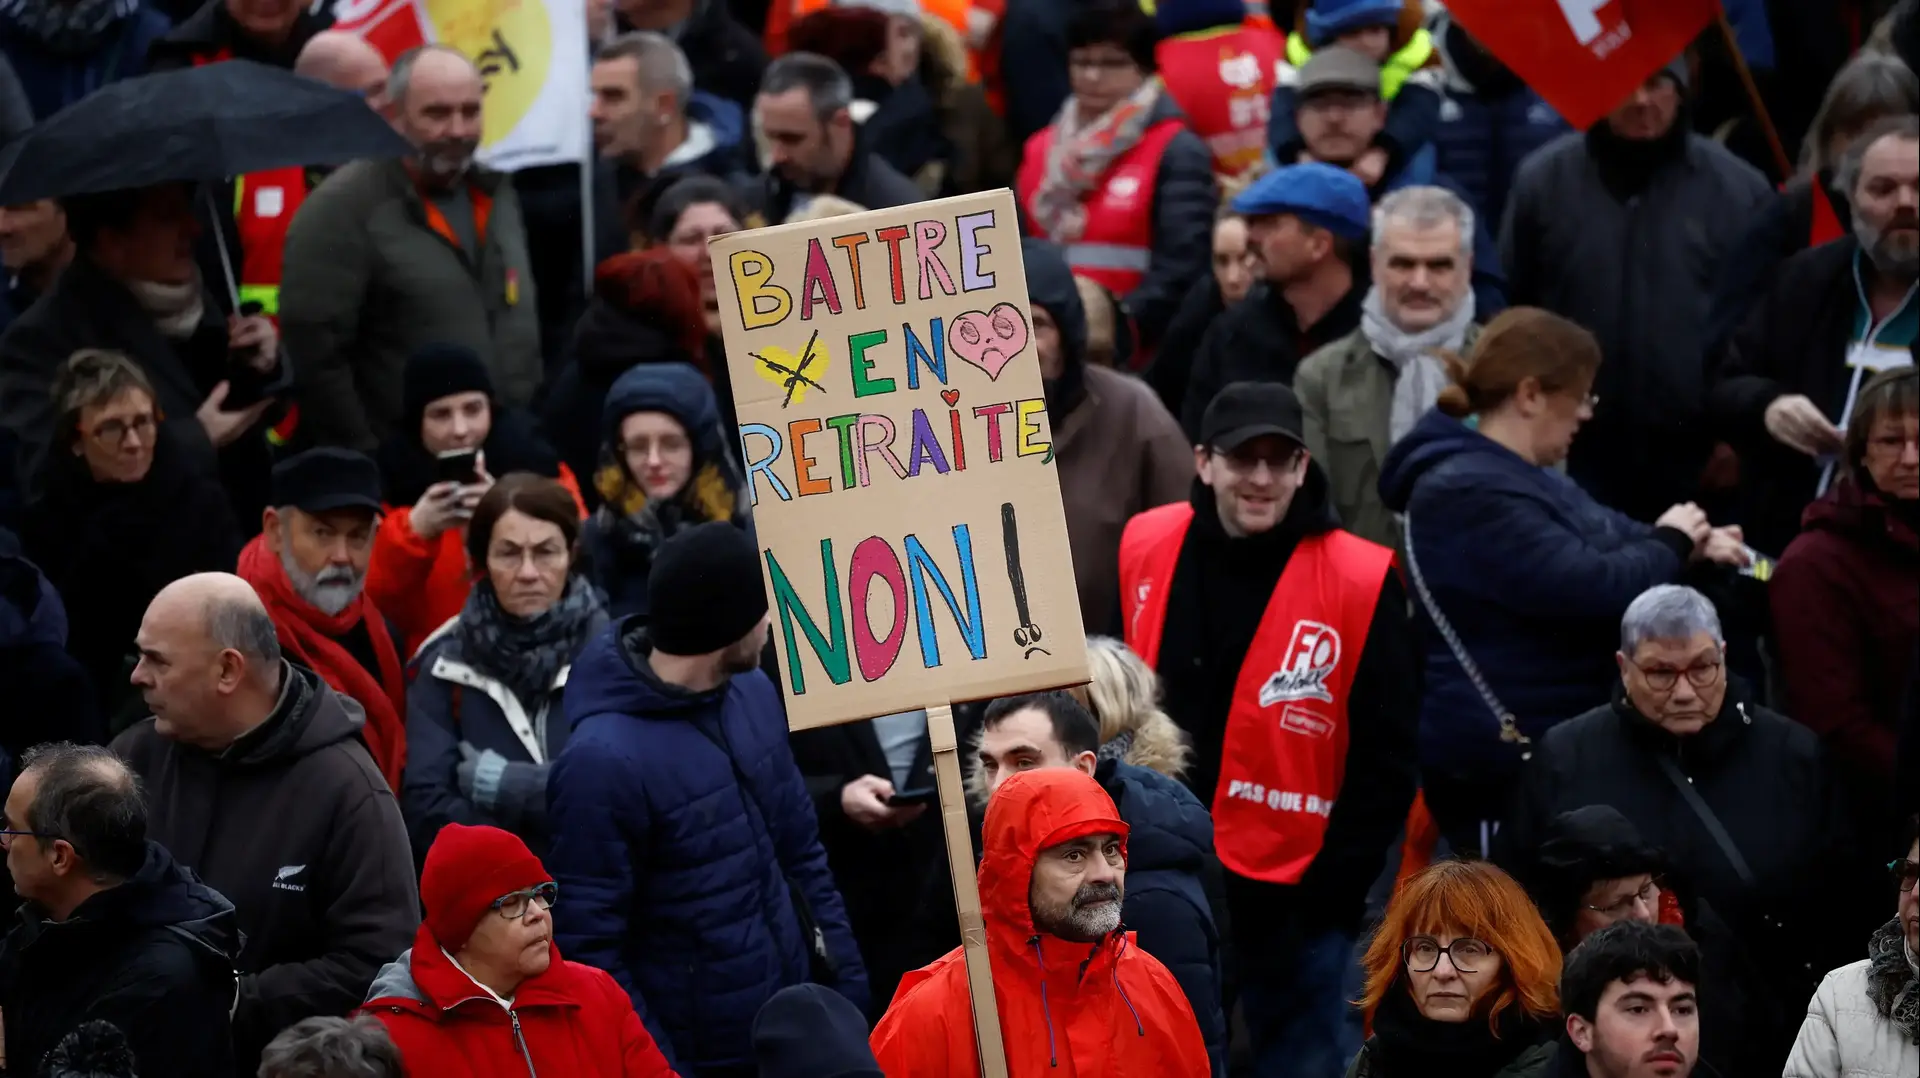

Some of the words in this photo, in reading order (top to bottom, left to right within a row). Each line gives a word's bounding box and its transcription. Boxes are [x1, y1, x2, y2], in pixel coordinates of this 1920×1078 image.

[729, 210, 997, 331] BATTRE
[848, 317, 948, 398] EN
[1282, 620, 1341, 673] FO
[1228, 779, 1265, 804] PAS
[1267, 789, 1303, 812] QUE
[281, 883, 304, 892] BLACKS
